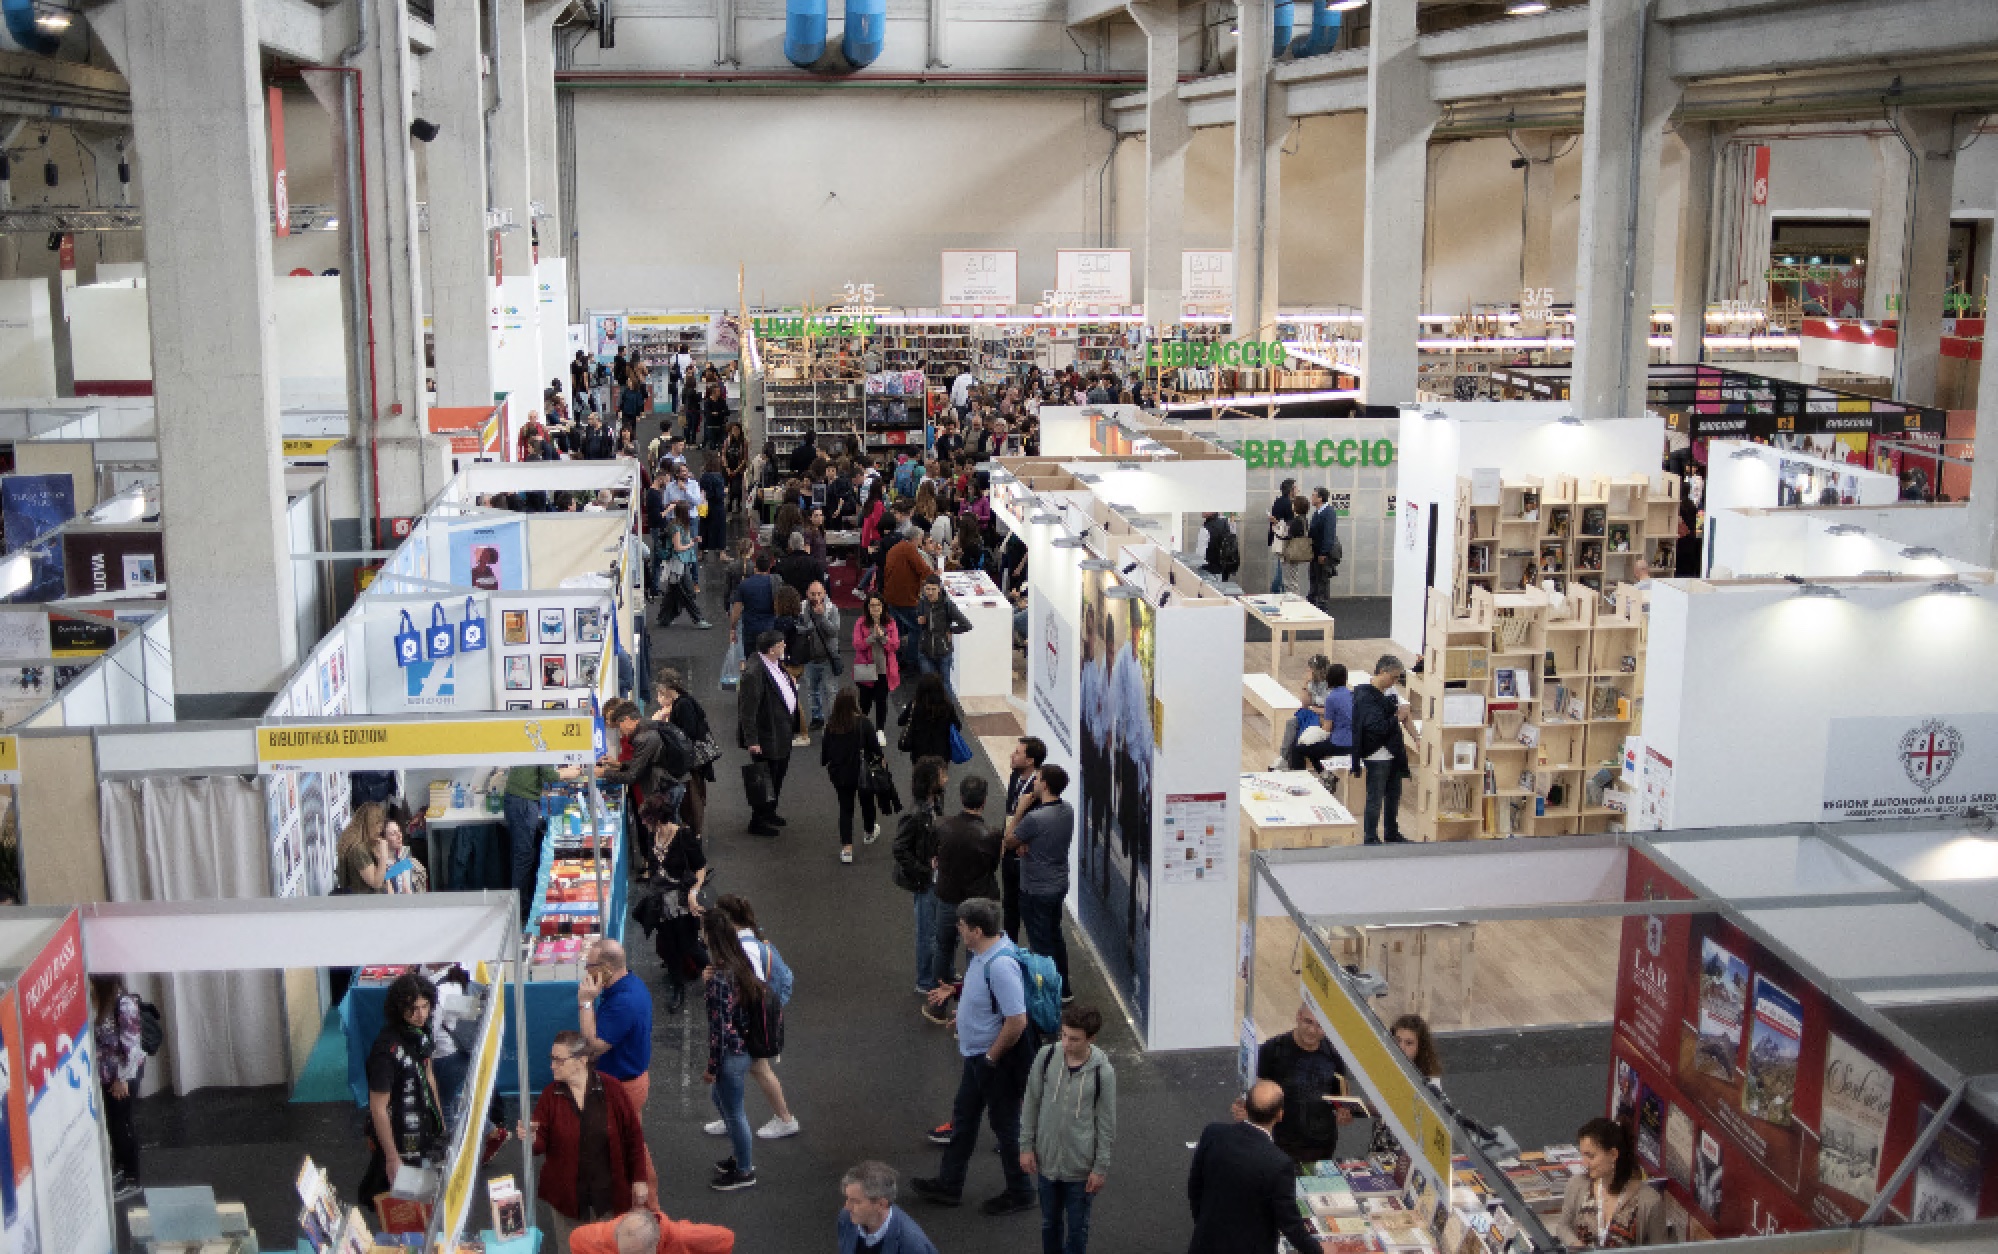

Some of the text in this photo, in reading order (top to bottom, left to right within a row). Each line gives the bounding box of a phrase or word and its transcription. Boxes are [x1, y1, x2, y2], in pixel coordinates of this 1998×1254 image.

[1523, 287, 1554, 307] 3/5
[754, 315, 877, 338] LIBRACCIO
[1146, 341, 1287, 367] LIBRACCIO
[1217, 438, 1393, 469] BRACCIO
[269, 727, 388, 747] BIBLIOTHEKA EDIZIONI
[561, 723, 582, 738] J21
[1823, 799, 1869, 811] REGIONE
[1872, 796, 1935, 808] AUTONOMA
[1937, 795, 1967, 806] DELLA
